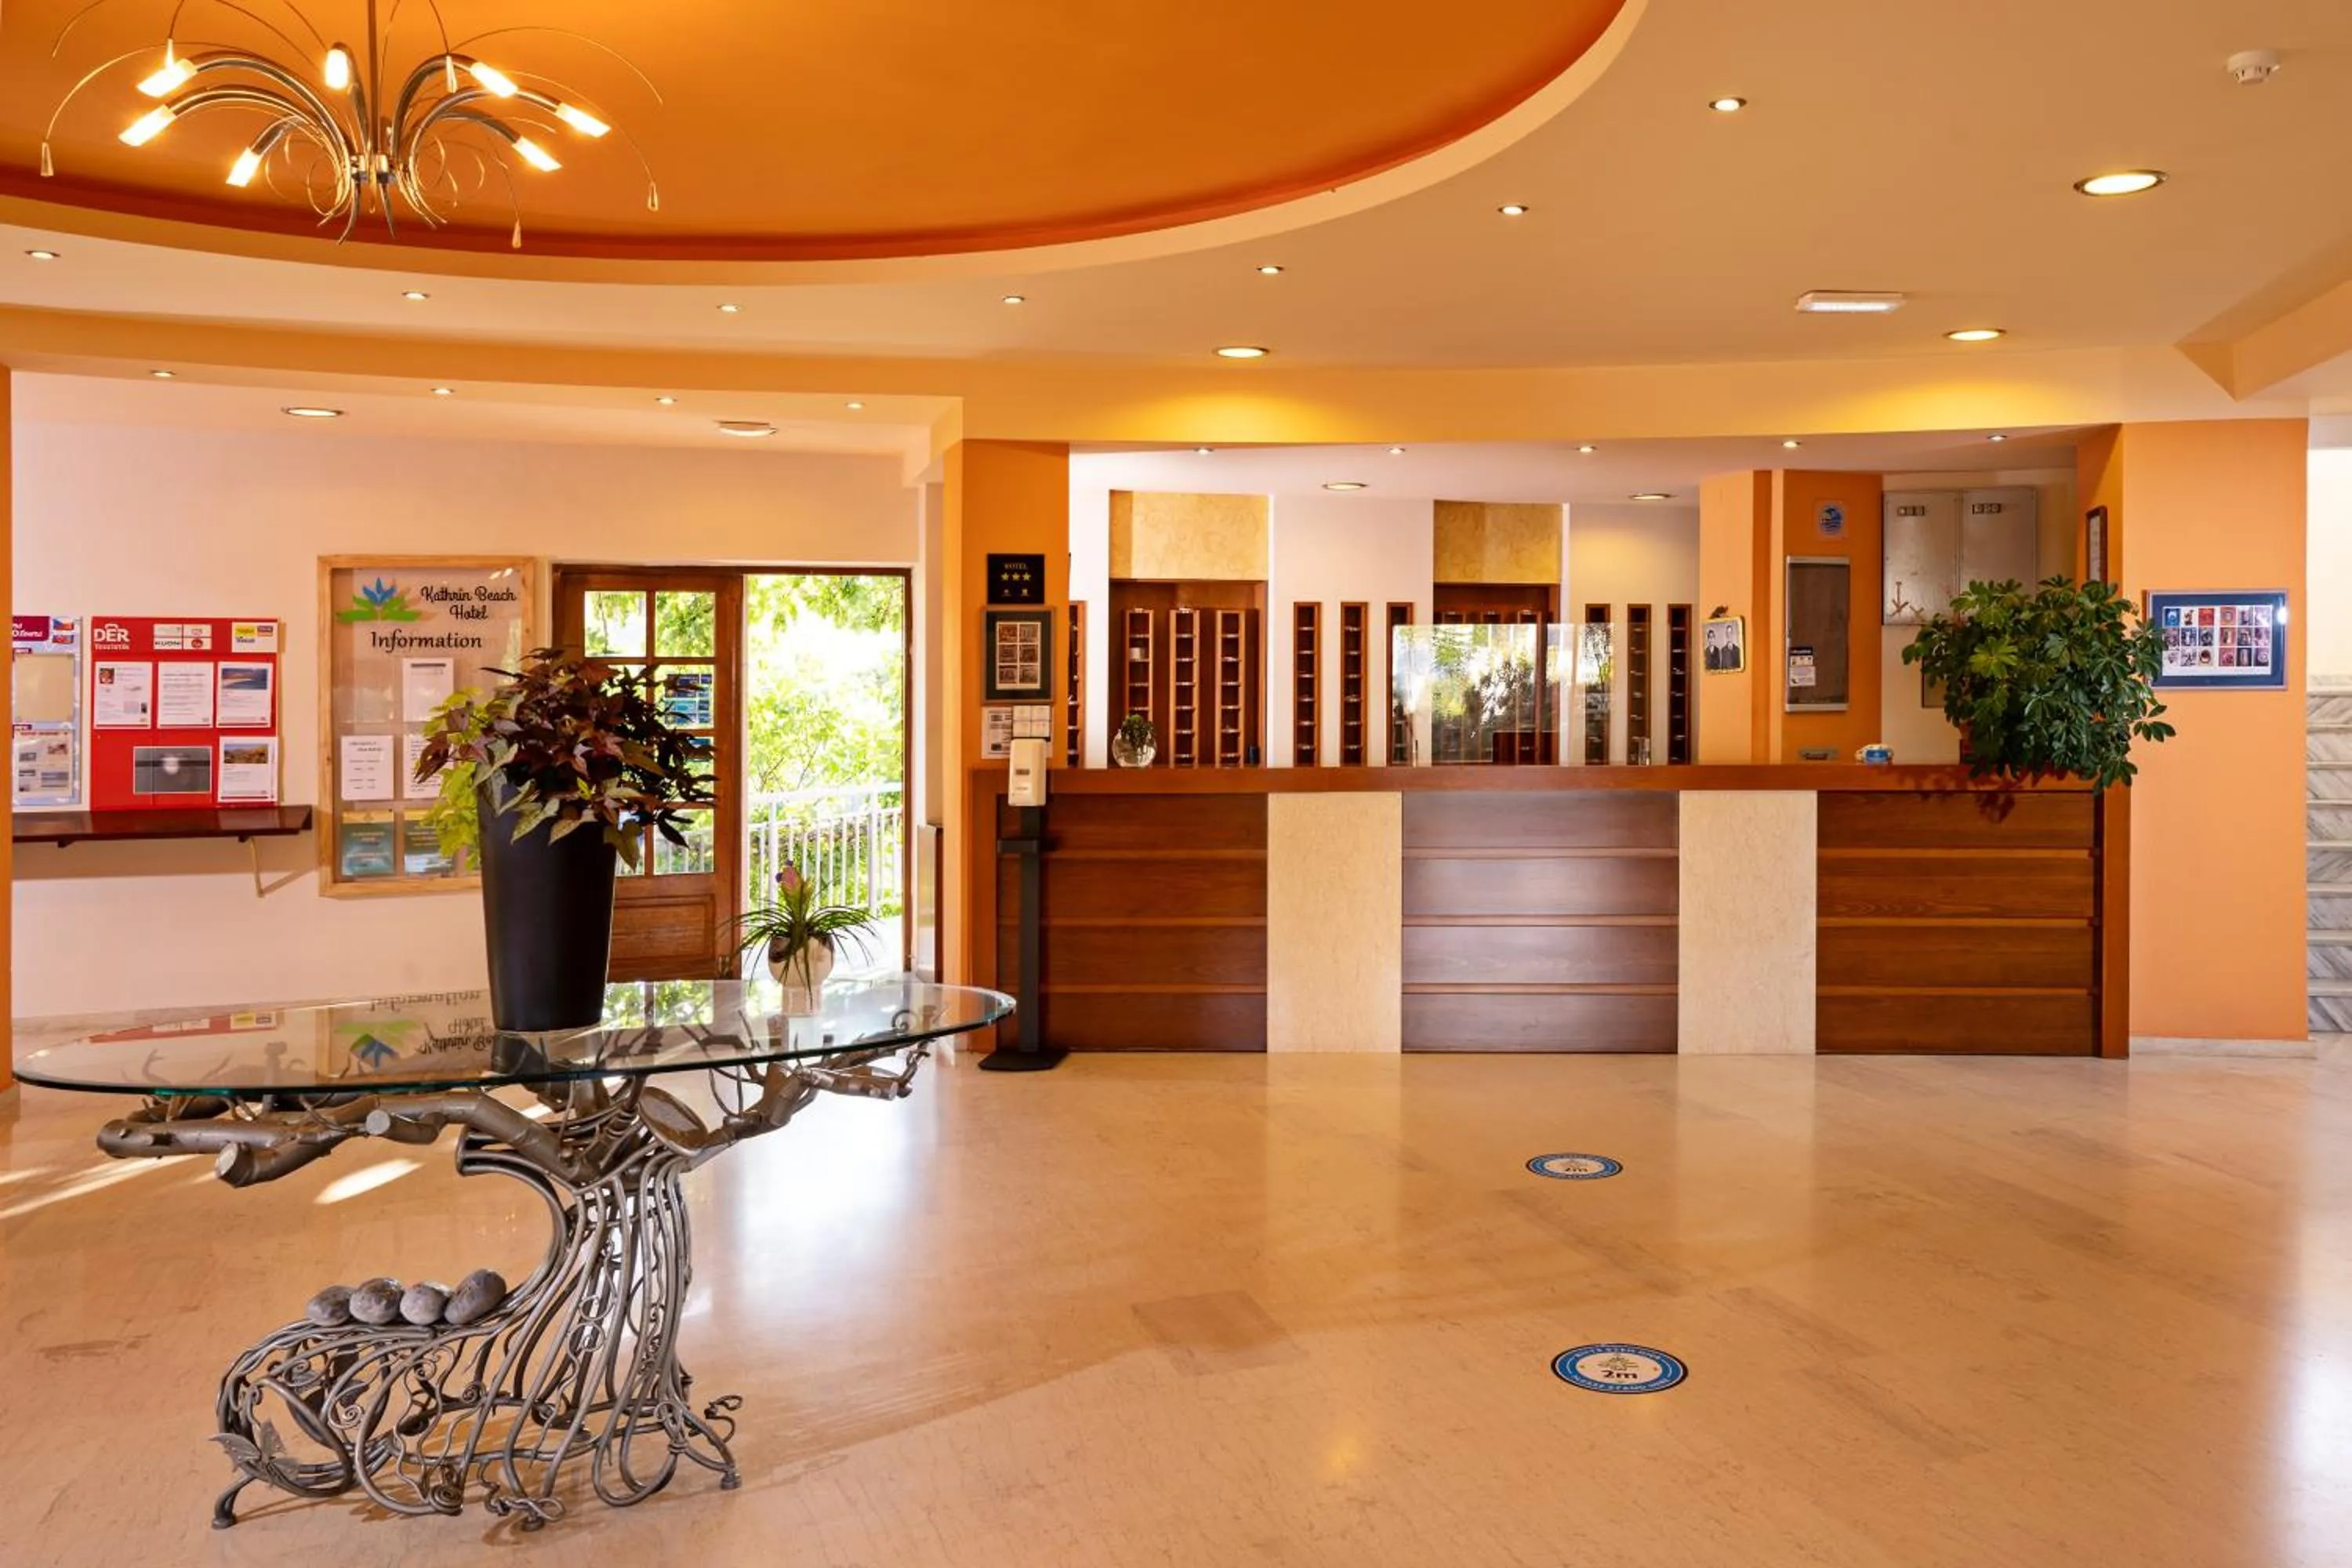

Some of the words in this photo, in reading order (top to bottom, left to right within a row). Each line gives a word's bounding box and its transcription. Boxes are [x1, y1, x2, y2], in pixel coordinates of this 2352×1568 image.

[420, 585, 473, 603] Kathrin
[474, 586, 517, 601] Beach
[449, 604, 488, 620] Hotel
[93, 628, 130, 642] DER
[370, 628, 483, 654] Information
[1601, 1370, 1638, 1379] 2m
